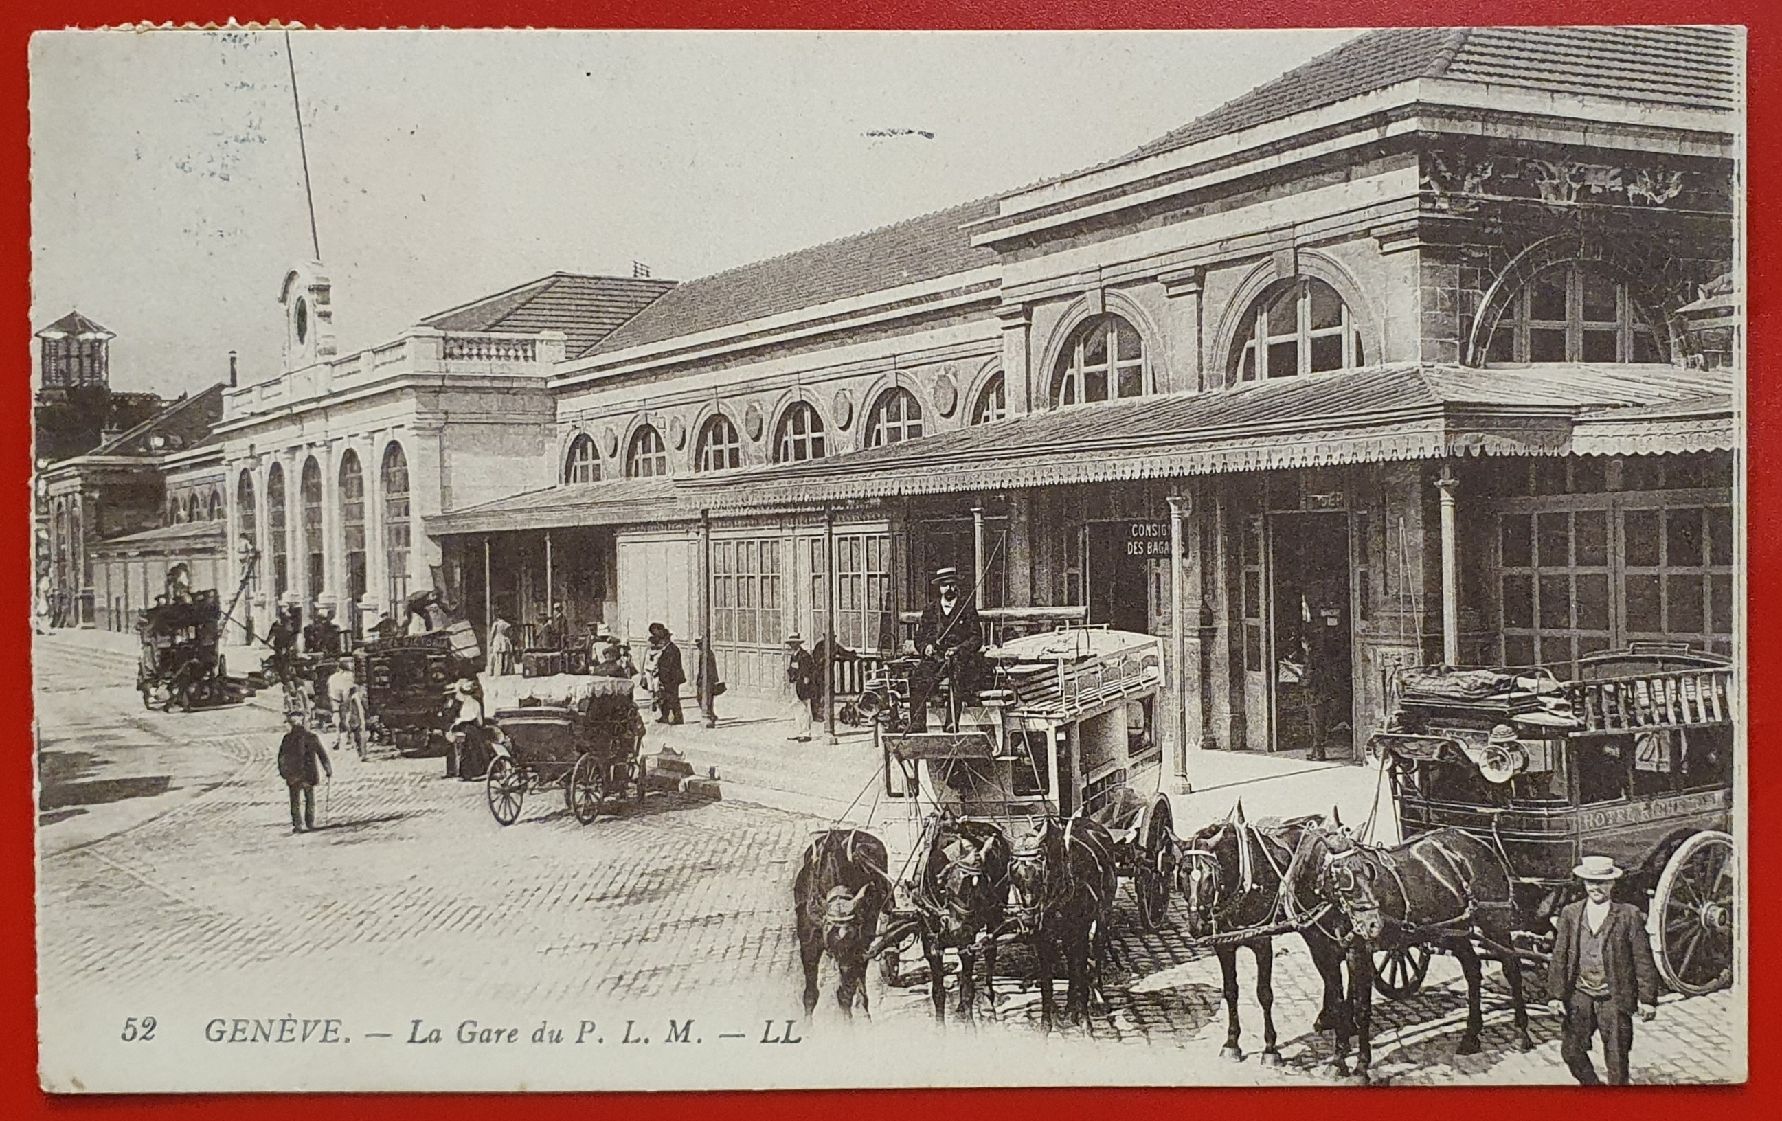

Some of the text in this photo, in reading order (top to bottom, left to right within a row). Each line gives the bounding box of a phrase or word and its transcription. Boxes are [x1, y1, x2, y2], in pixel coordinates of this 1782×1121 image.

[1131, 523, 1171, 537] CONSIG
[1127, 540, 1185, 555] DES BAGAS
